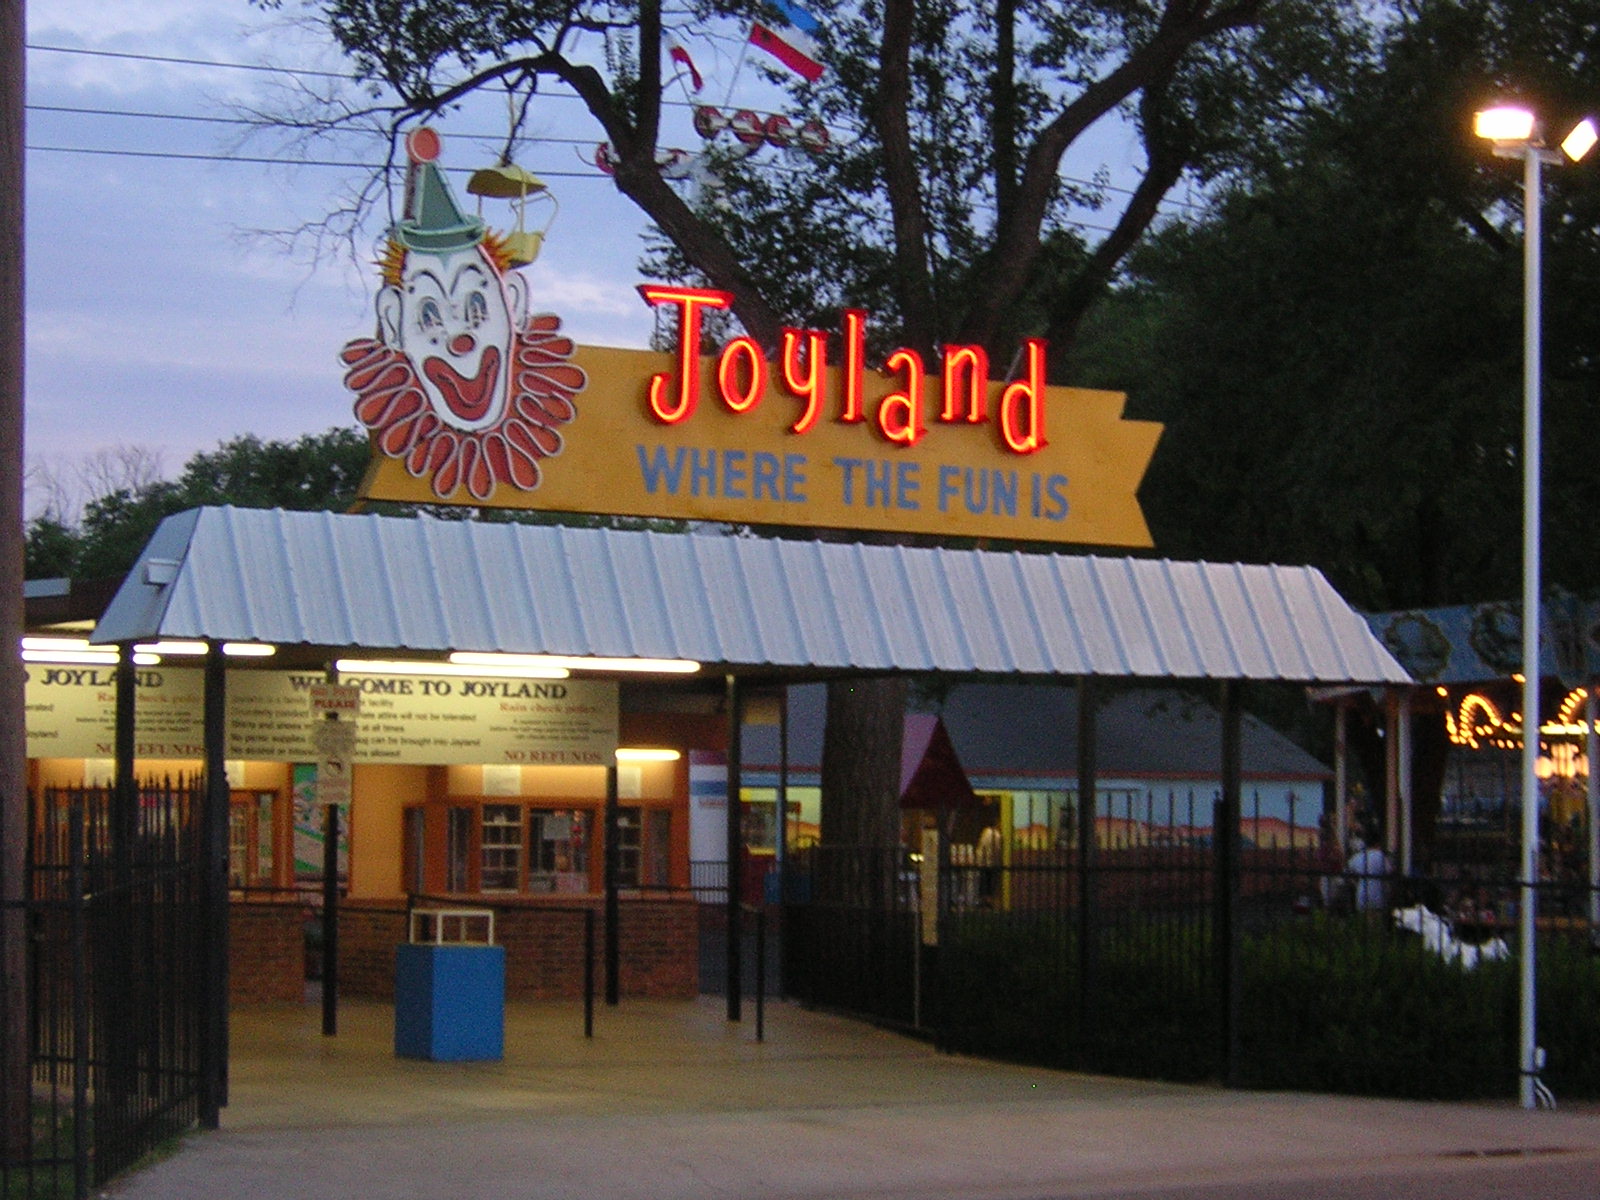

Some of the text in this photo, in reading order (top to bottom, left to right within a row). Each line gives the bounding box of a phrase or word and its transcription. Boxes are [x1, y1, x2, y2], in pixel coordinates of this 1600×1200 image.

[636, 284, 1048, 455] Joyland
[636, 443, 1070, 522] WHERE THE FUN IS
[287, 675, 568, 699] WECOME TO JOYLAND
[135, 743, 206, 756] EFUNDS
[504, 750, 526, 762] NO
